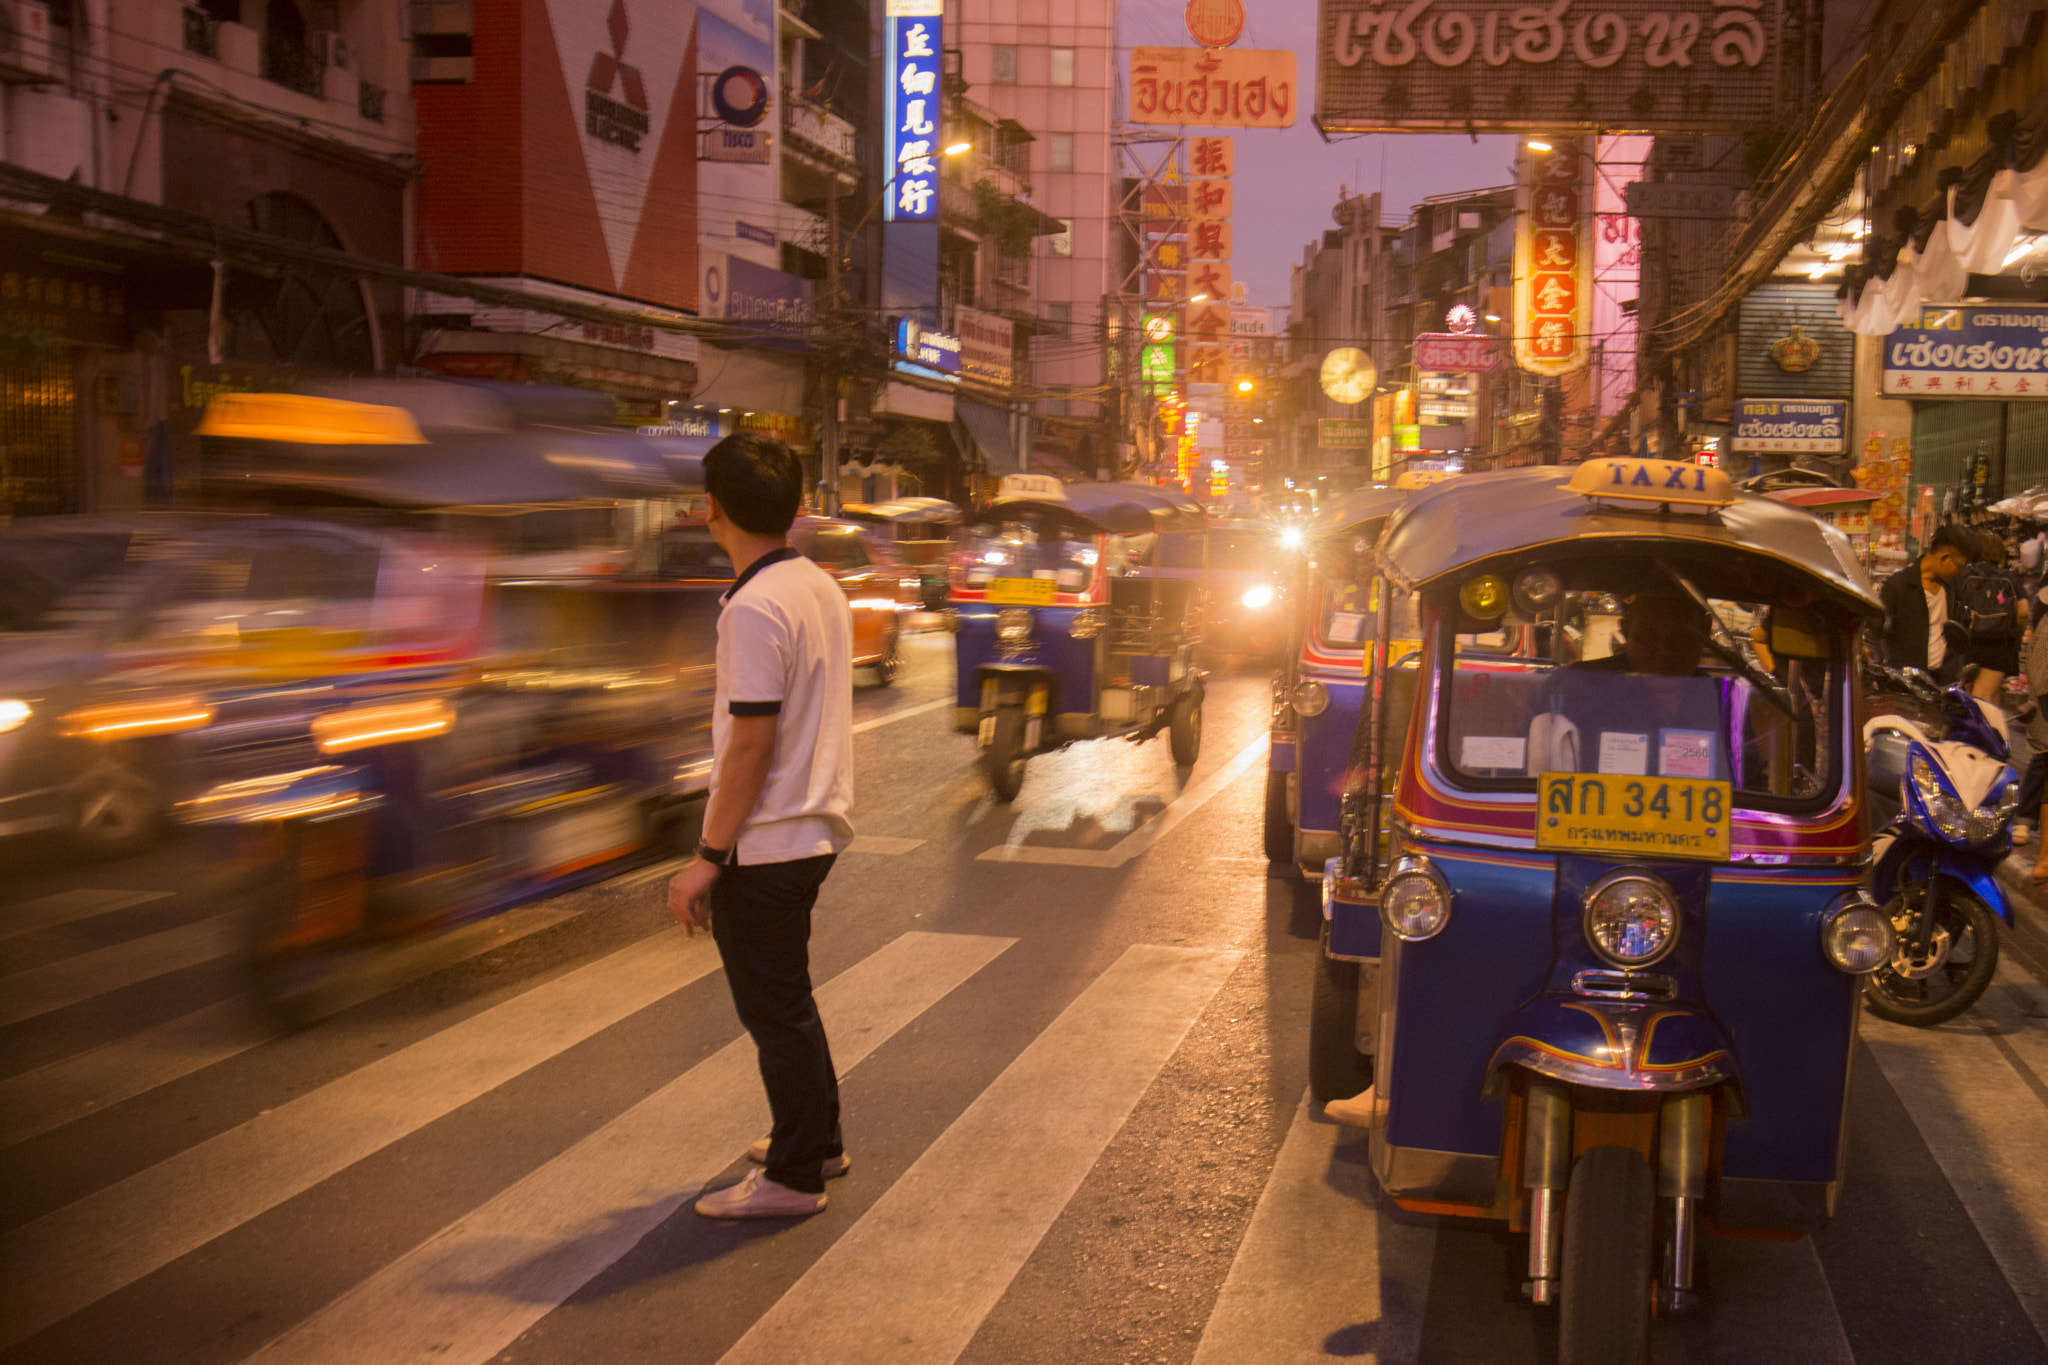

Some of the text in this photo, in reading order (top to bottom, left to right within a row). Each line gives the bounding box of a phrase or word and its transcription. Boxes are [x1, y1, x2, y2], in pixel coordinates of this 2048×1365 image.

[1334, 0, 1765, 67] เซงเฮงหล
[721, 131, 754, 149] TISCO
[1896, 374, 2048, 393] 成興利大金
[1743, 404, 1779, 416] ทอง
[1737, 416, 1841, 438] เซ่งเฮงหลี
[1606, 461, 1708, 492] TAXI
[1682, 746, 1709, 759] 2560
[1547, 775, 1723, 824] สก 3418
[1567, 826, 1701, 847] กรุงเทพมหานคร
